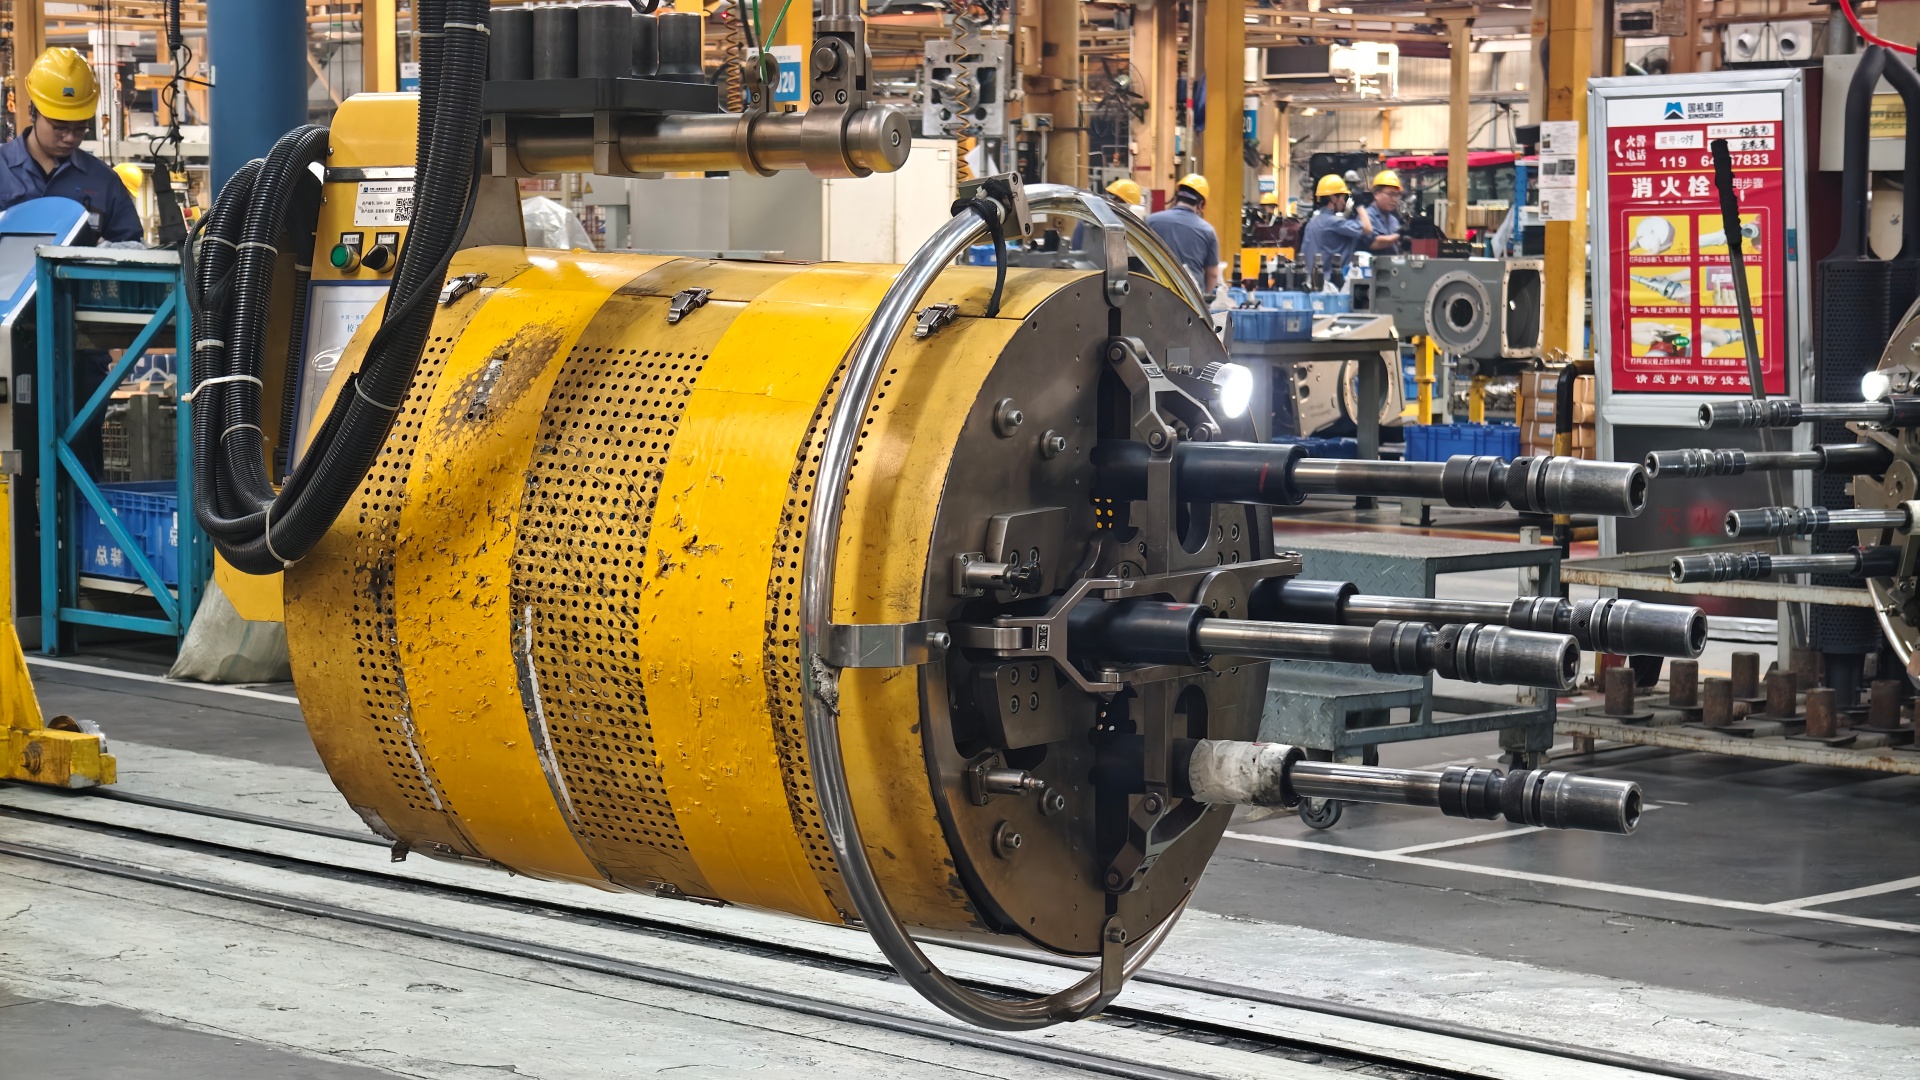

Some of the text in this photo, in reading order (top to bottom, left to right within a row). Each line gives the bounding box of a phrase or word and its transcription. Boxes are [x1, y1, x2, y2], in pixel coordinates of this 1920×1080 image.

[1688, 102, 1723, 113] 国机集团
[1626, 134, 1647, 148] 火警
[1626, 149, 1647, 161] 电话
[1659, 156, 1687, 168] 119
[1631, 175, 1764, 199] 消火栓 用步骤
[1635, 374, 1750, 386] 请爱护消防设施
